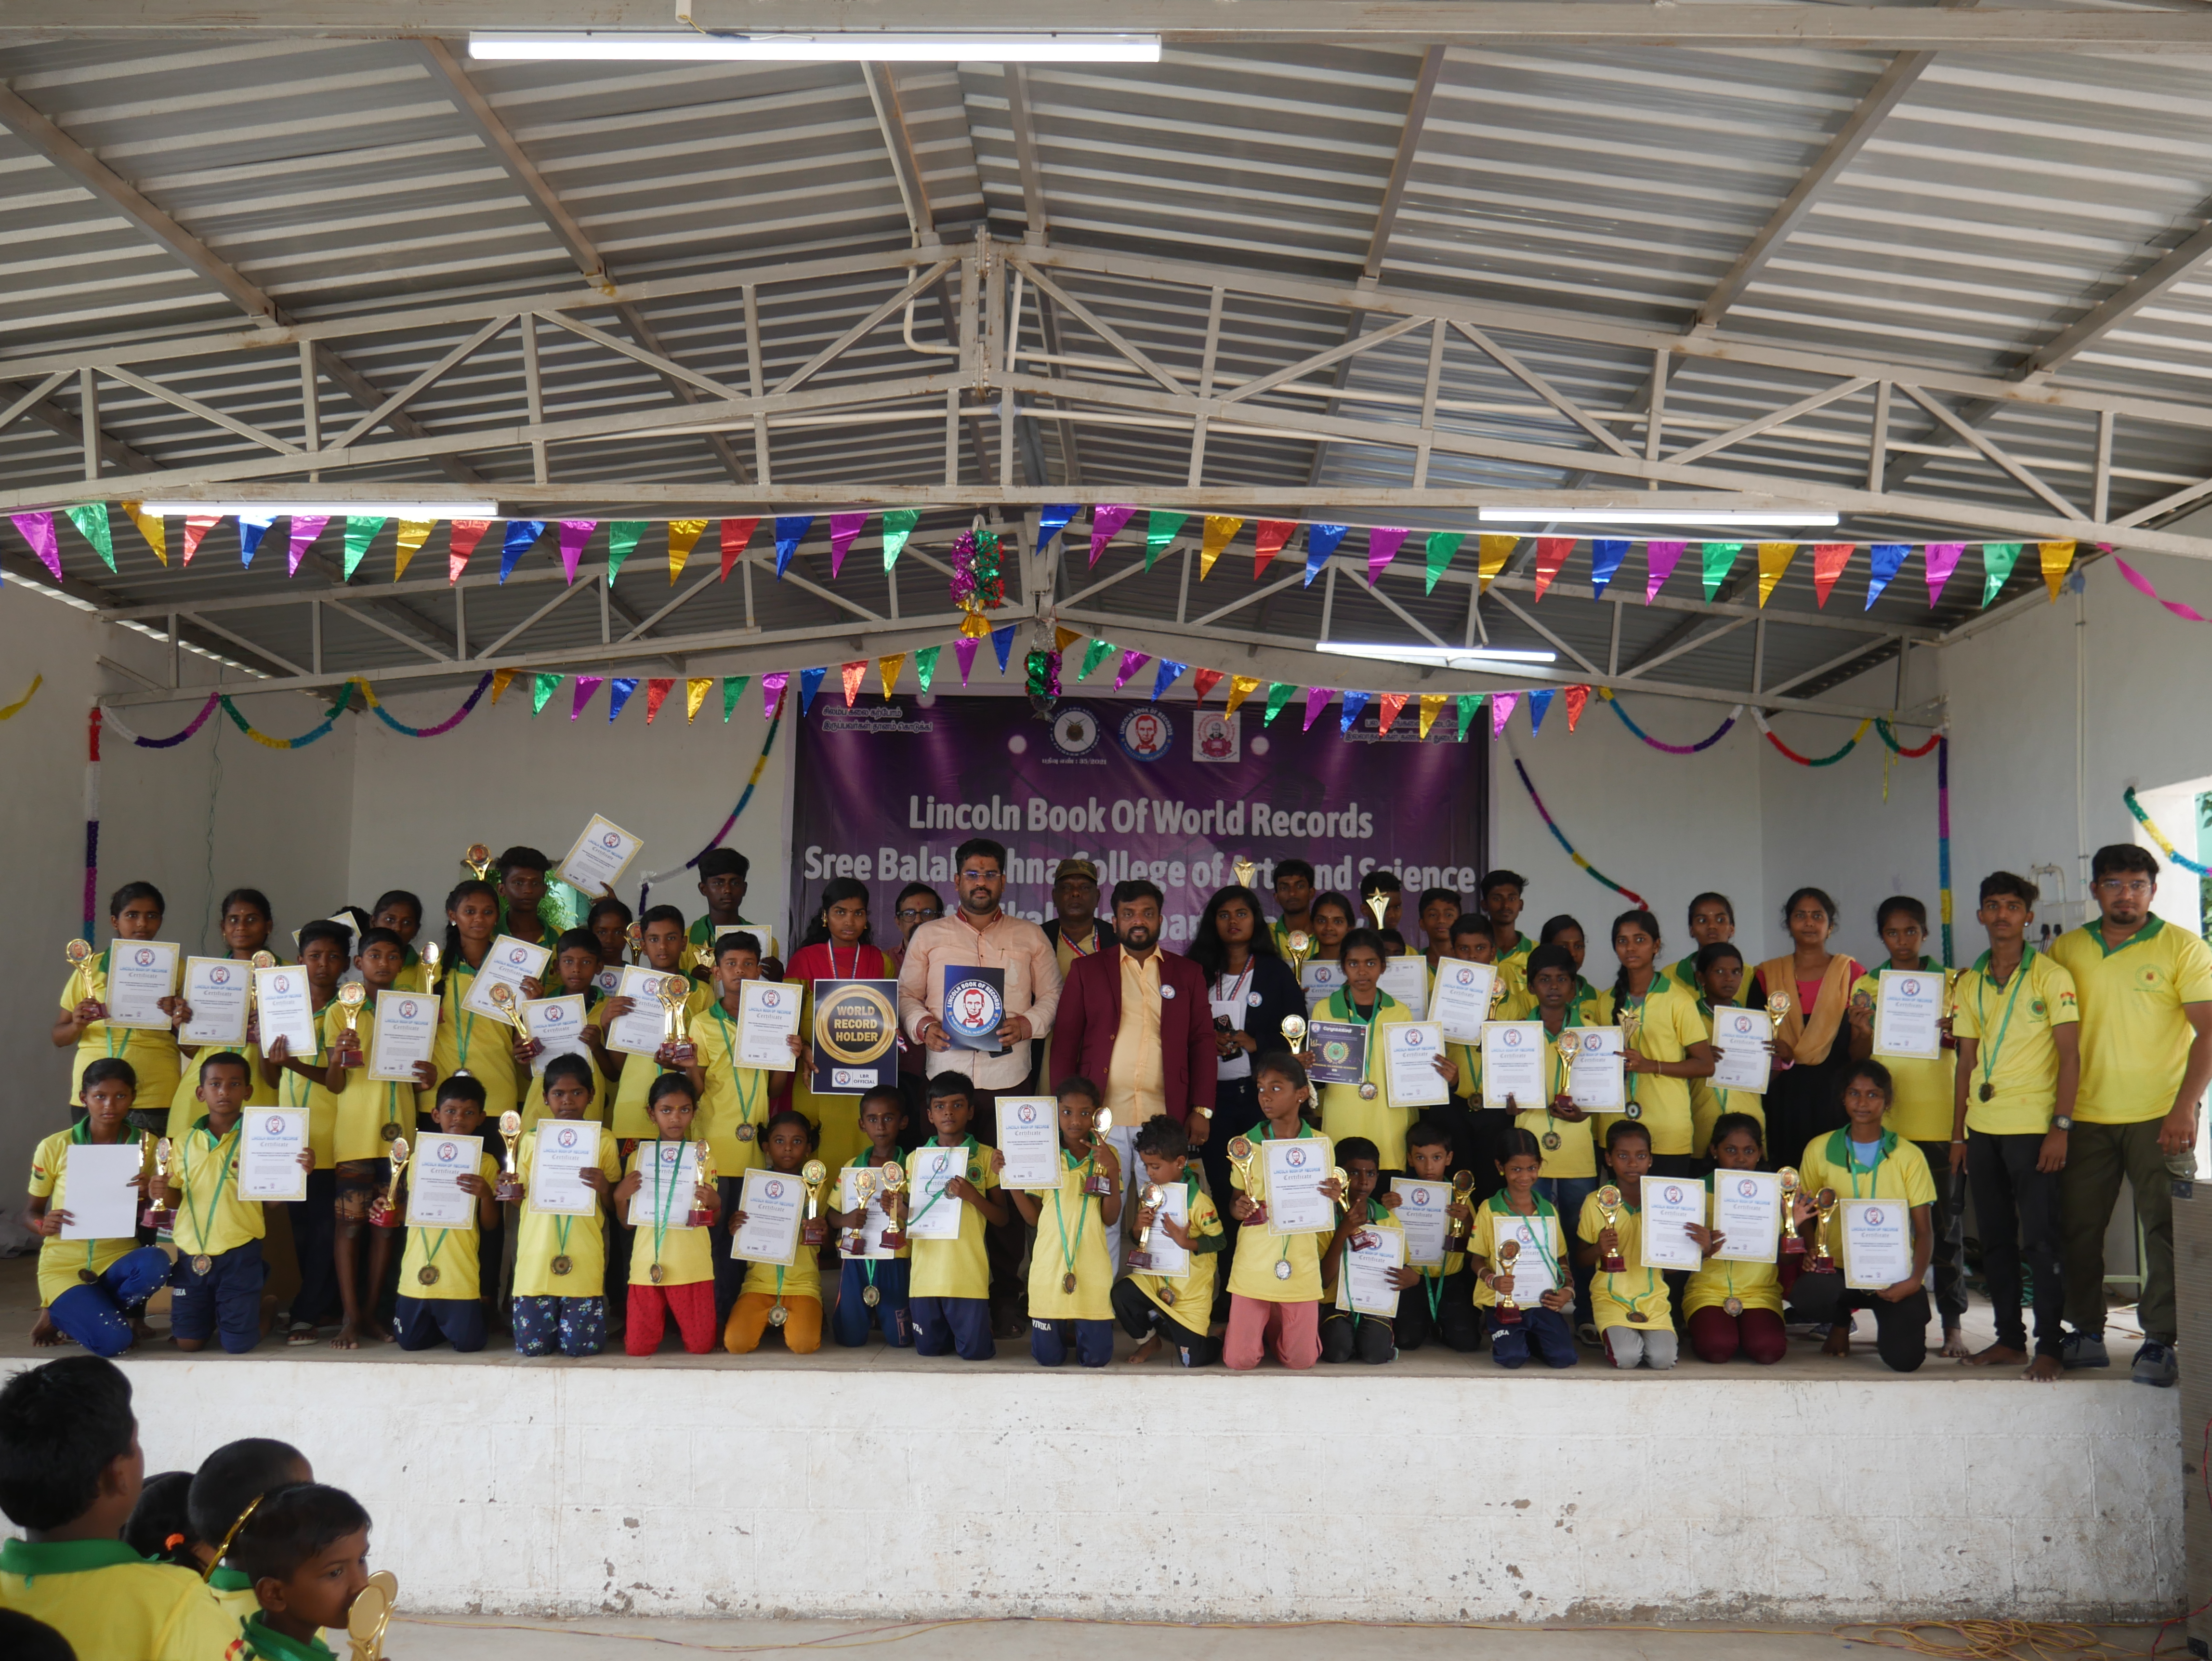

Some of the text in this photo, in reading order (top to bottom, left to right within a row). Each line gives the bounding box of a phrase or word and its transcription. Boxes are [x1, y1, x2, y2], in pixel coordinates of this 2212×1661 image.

[909, 795, 1374, 839] Lincoln Book Of World Records
[804, 845, 872, 882] Sree
[1191, 853, 1224, 888] of
[947, 987, 962, 1008] LINCOLN
[984, 986, 1001, 1011] RECORDS
[837, 1006, 875, 1016] WORLD
[834, 1019, 878, 1029] RECORD
[835, 1032, 878, 1042] HOLDER
